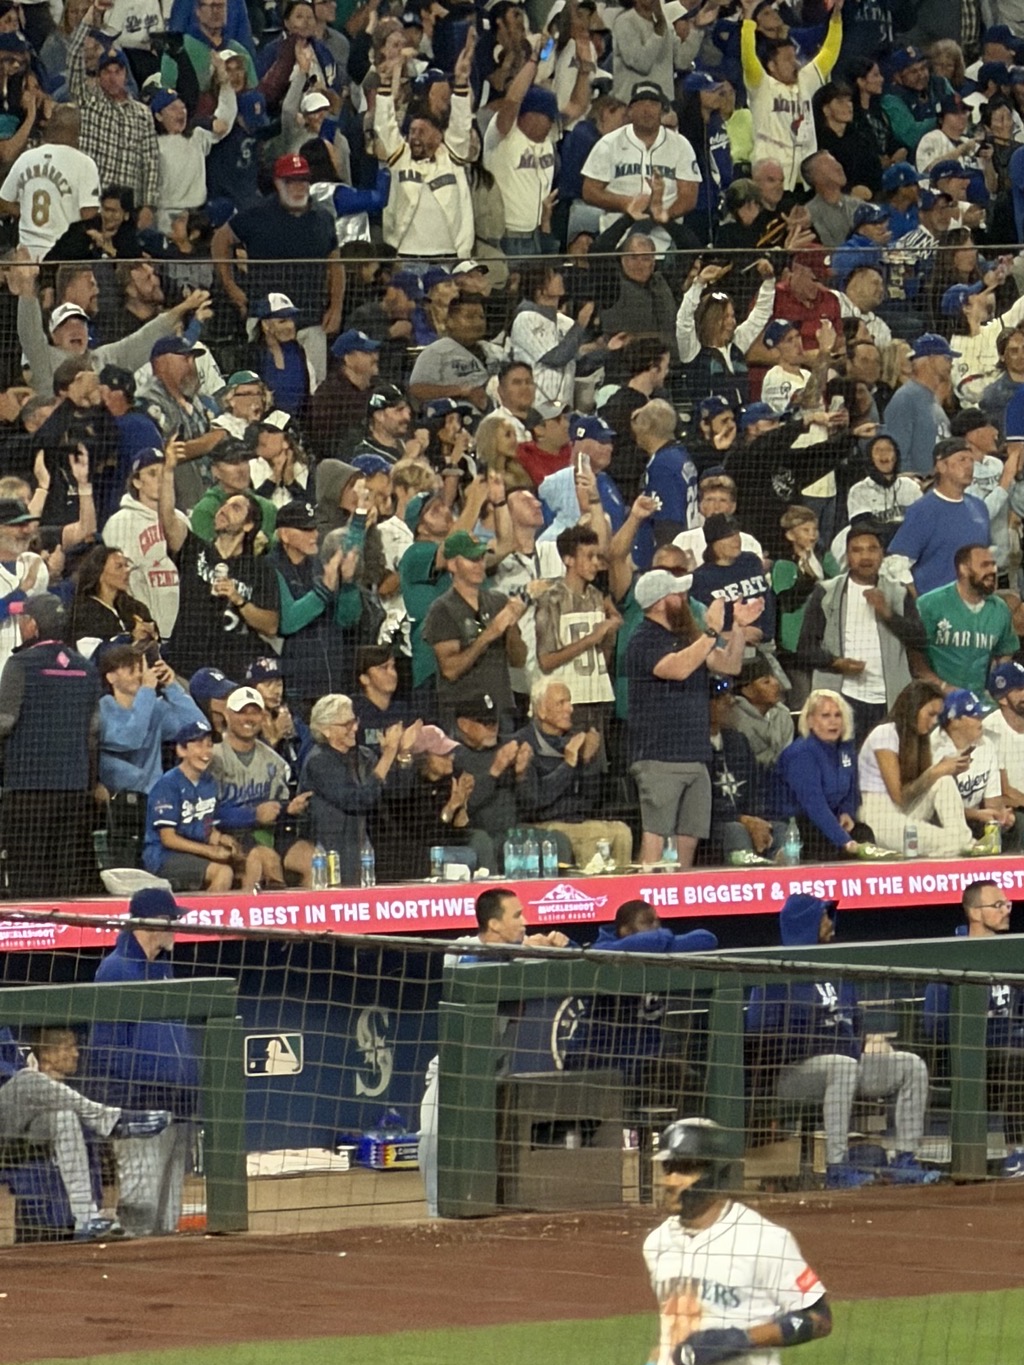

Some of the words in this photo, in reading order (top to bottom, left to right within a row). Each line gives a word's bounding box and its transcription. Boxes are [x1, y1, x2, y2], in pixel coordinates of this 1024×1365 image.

[32, 188, 51, 228] 8
[639, 886, 679, 906] THE
[683, 882, 766, 905] BIGGEST
[770, 881, 785, 900] &
[841, 878, 862, 897] IN
[865, 876, 904, 896] THE
[229, 908, 244, 924] &
[249, 905, 300, 923] BEST
[304, 903, 326, 921] IN
[330, 902, 371, 920] THE
[375, 897, 476, 918] NORTHWE
